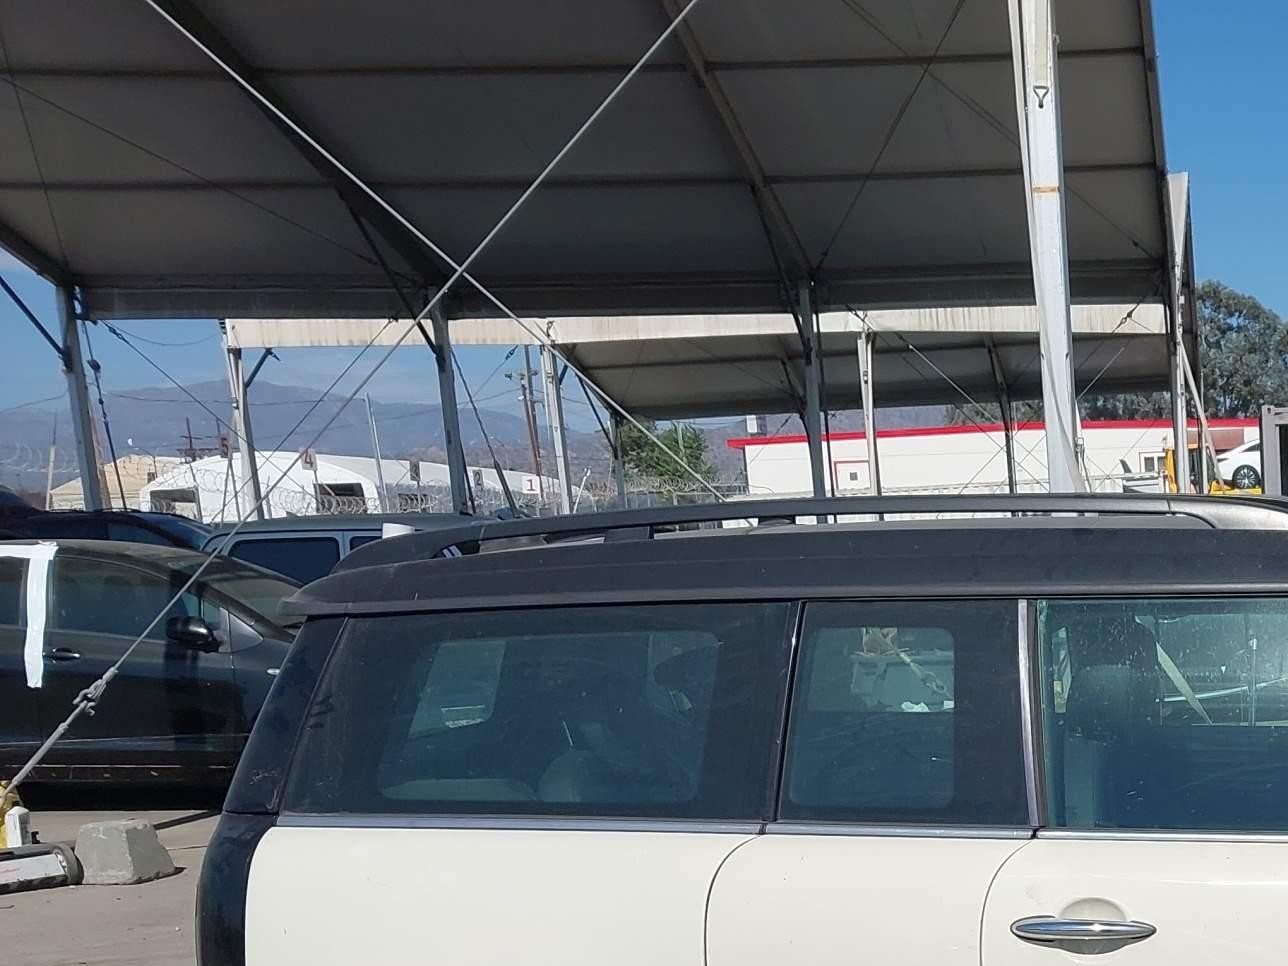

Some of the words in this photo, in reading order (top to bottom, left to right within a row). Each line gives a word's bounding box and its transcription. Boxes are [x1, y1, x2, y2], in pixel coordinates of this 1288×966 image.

[304, 447, 314, 468] 4
[475, 471, 483, 486] 2
[526, 478, 536, 491] 1
